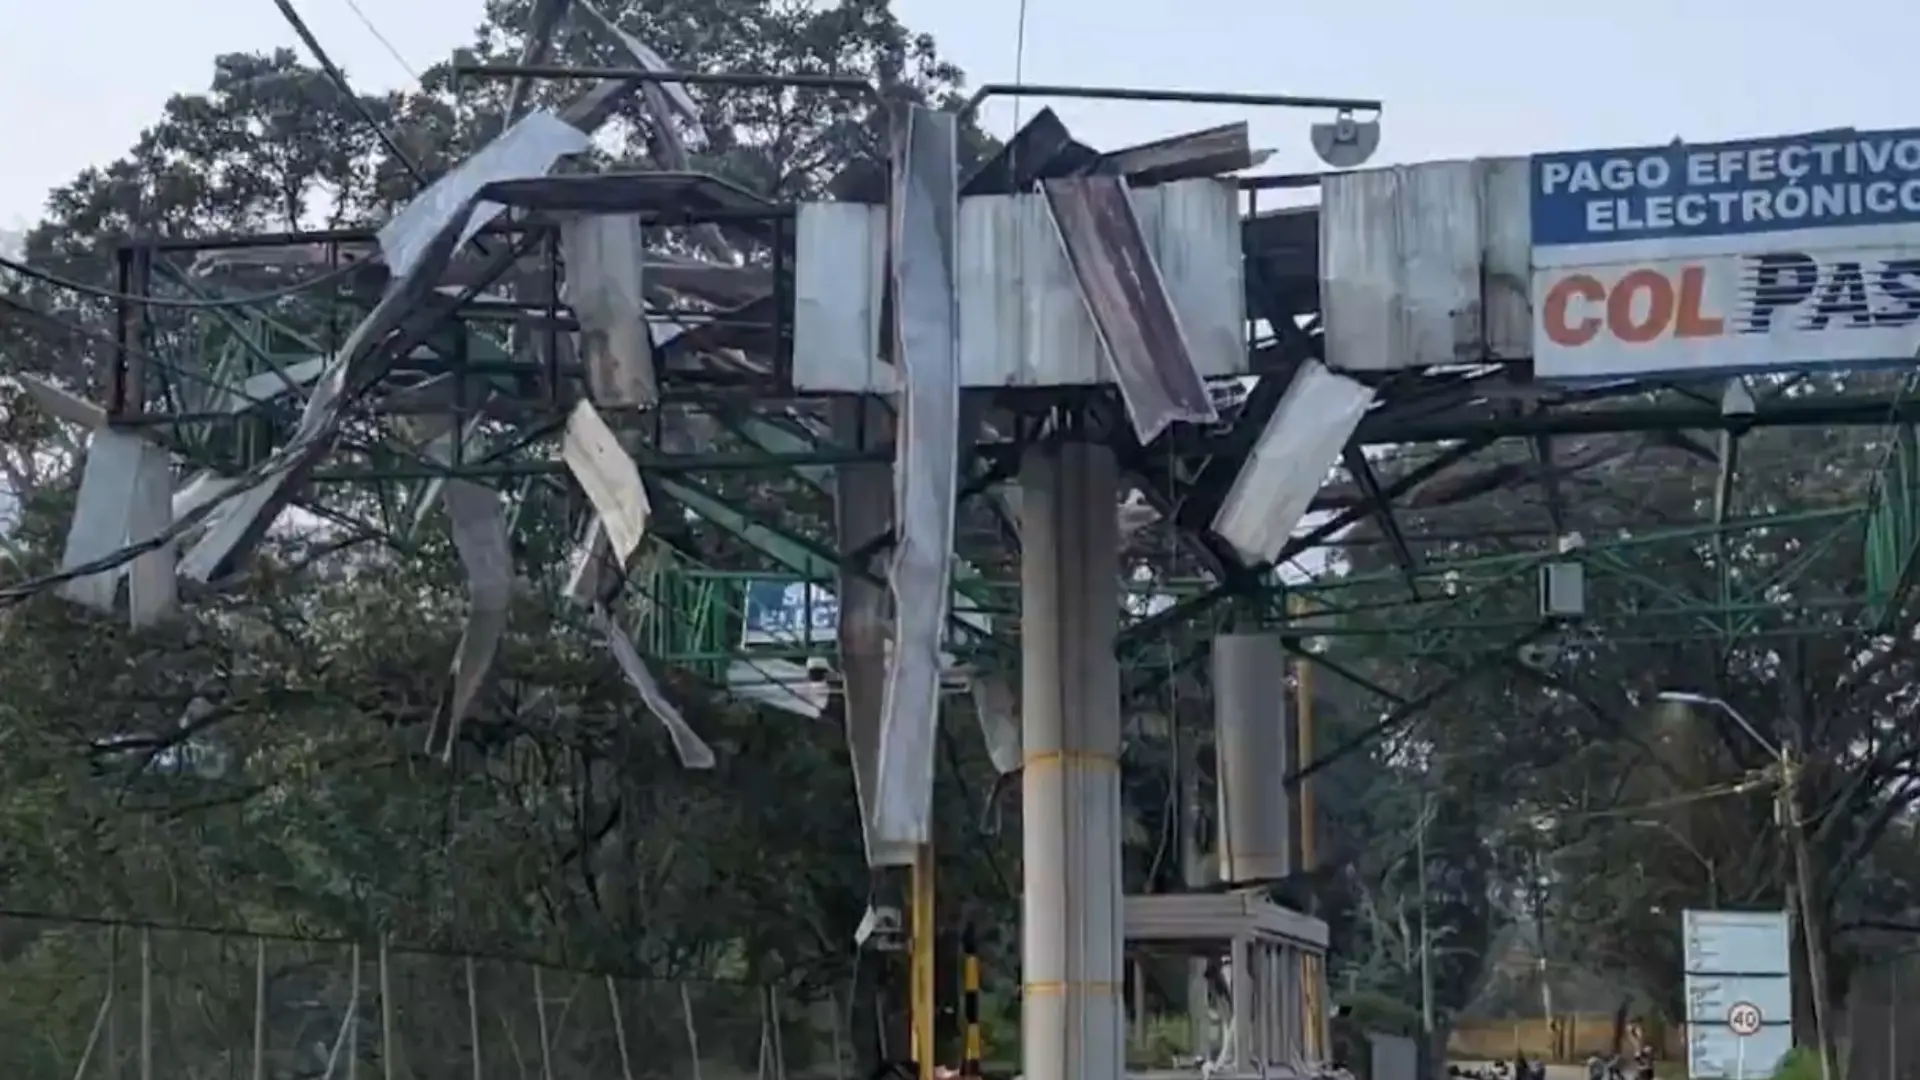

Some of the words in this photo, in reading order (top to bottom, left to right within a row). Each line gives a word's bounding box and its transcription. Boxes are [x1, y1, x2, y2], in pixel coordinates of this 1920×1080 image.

[1542, 156, 1670, 195] PAGO
[1687, 139, 1920, 186] EFECTIVO
[1733, 1010, 1757, 1028] 40
